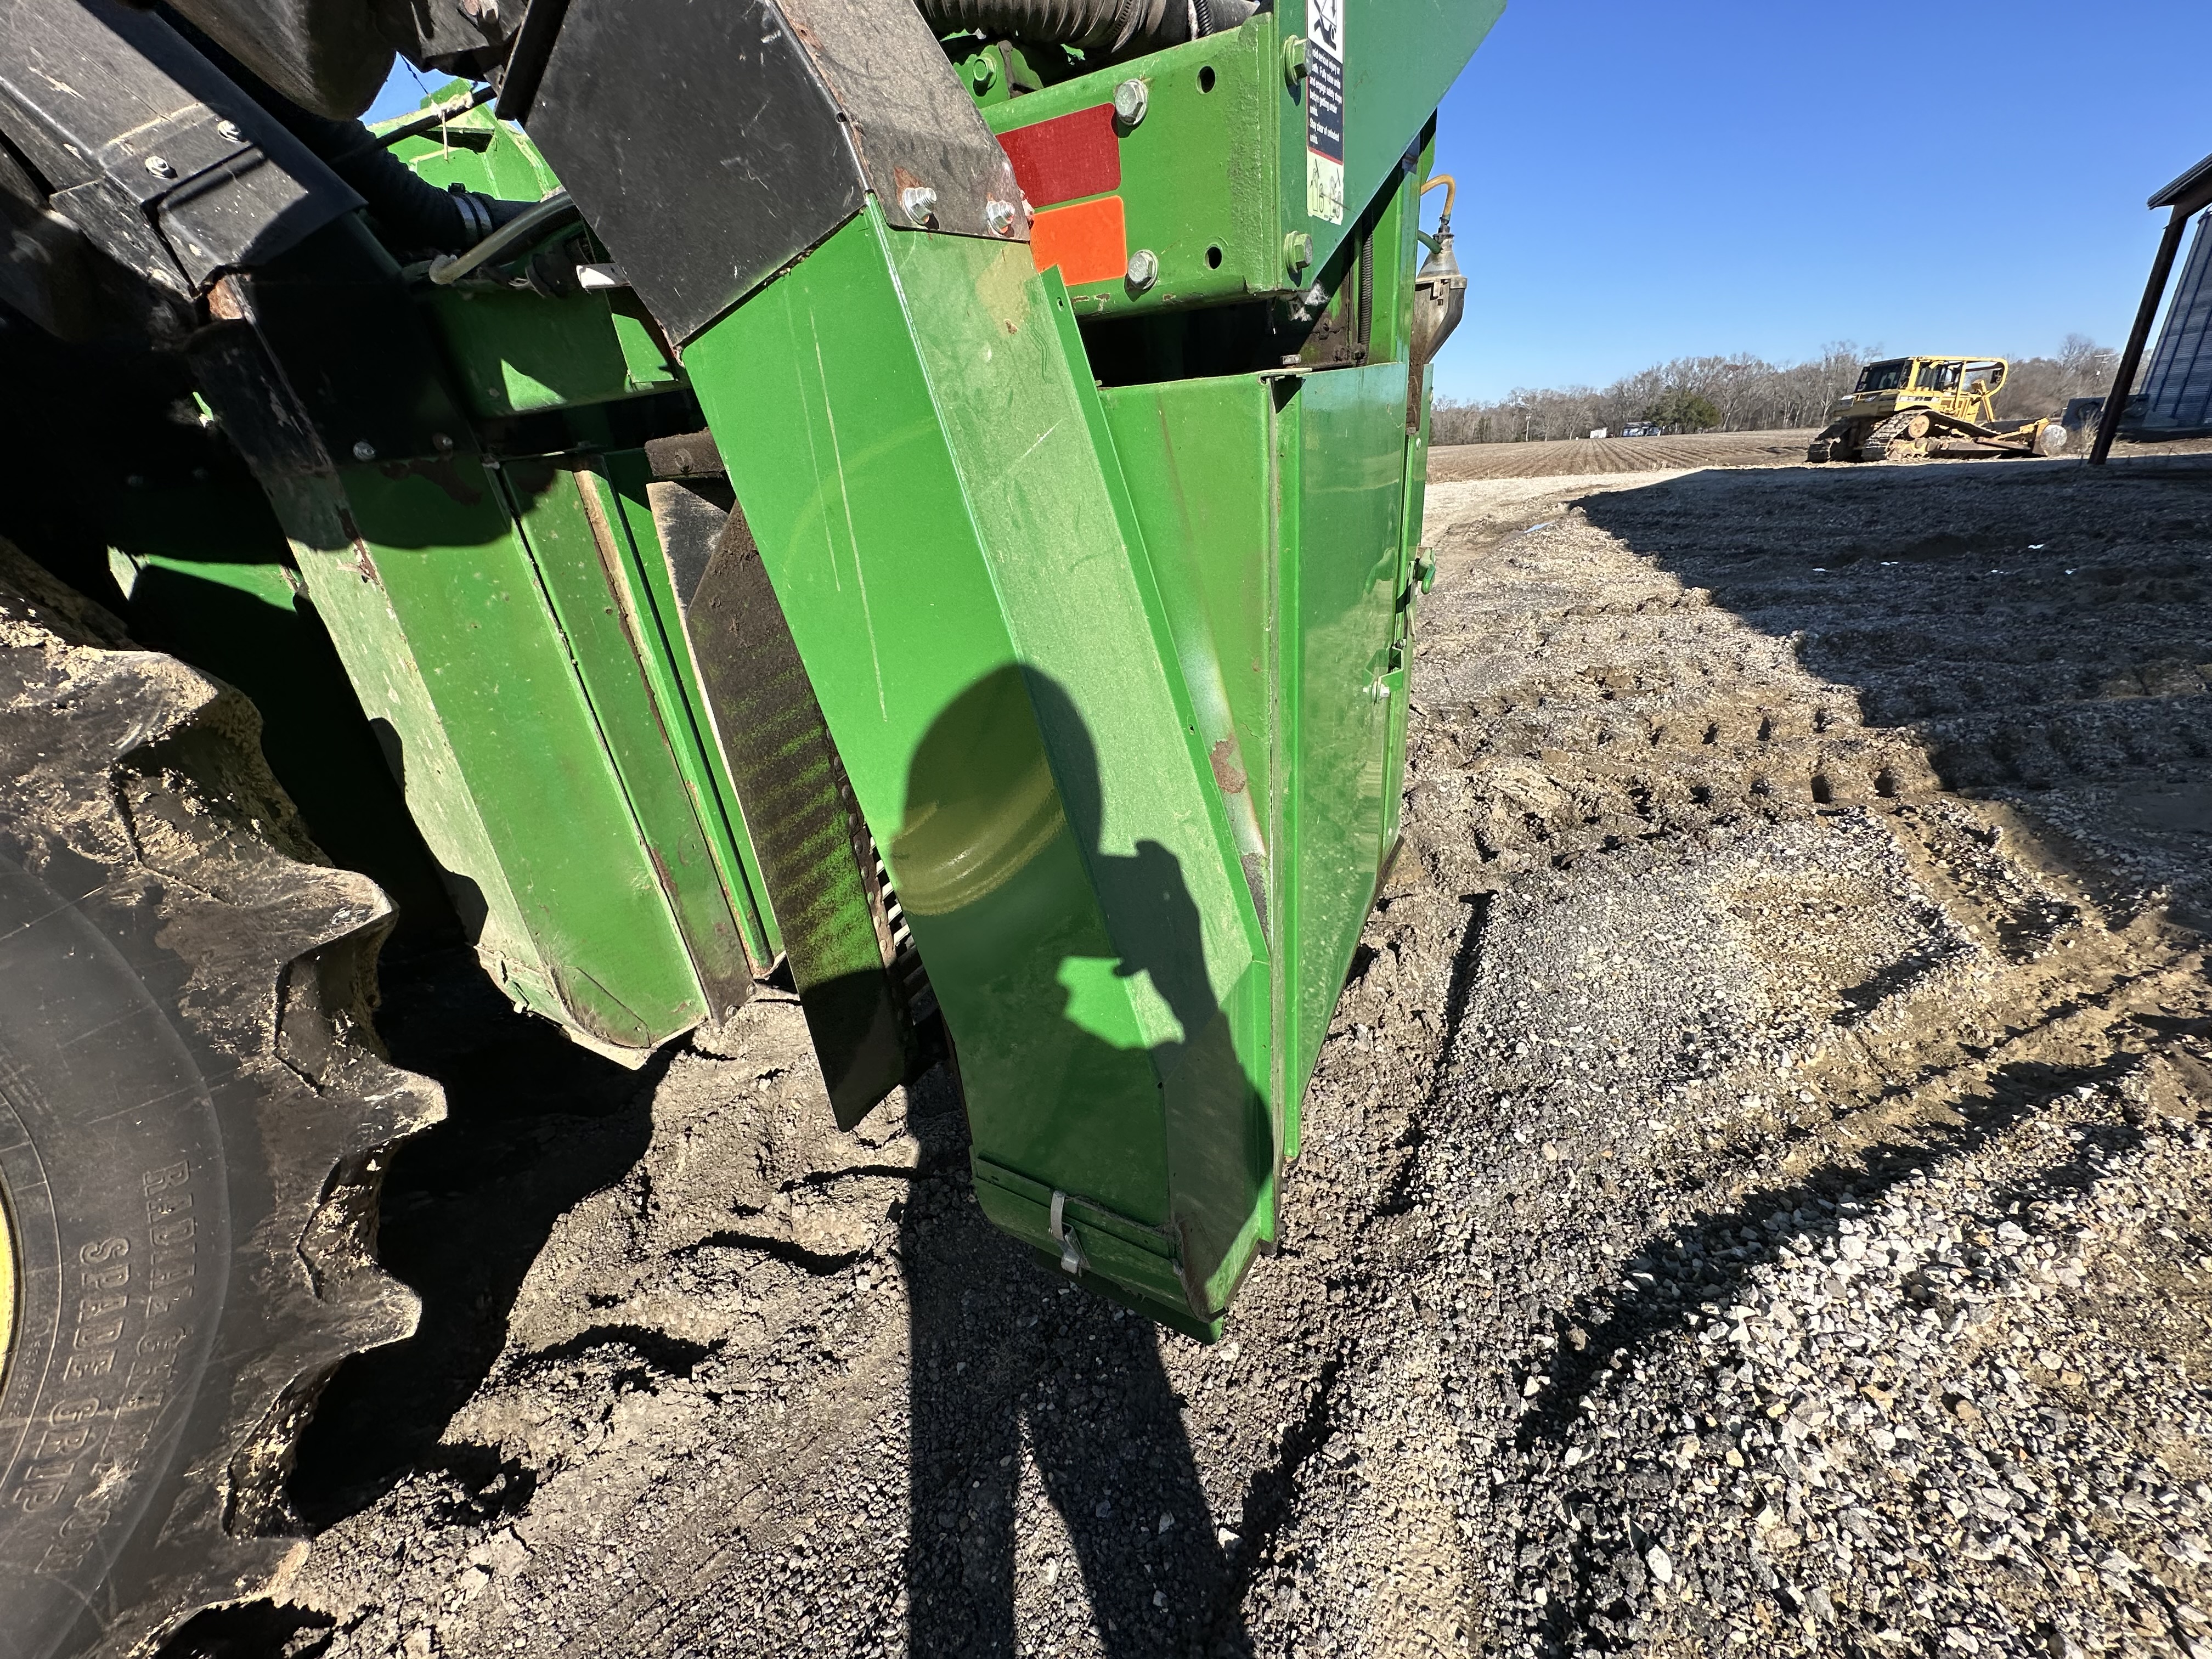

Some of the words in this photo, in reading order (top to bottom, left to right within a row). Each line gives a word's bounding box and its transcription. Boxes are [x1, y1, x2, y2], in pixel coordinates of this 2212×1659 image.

[1318, 53, 1329, 67] serious
[1336, 67, 1340, 75] or
[1316, 80, 1326, 95] engage
[1310, 88, 1319, 103] before
[1319, 97, 1329, 111] getting
[1329, 103, 1338, 114] under
[1310, 105, 1318, 117] units.
[1310, 134, 1318, 144] units.
[1324, 126, 1327, 135] of
[1327, 129, 1340, 142] unlocked
[143, 1159, 196, 1318] RADIAL
[63, 1237, 130, 1381] SPADE
[13, 1397, 101, 1512] GRIP
